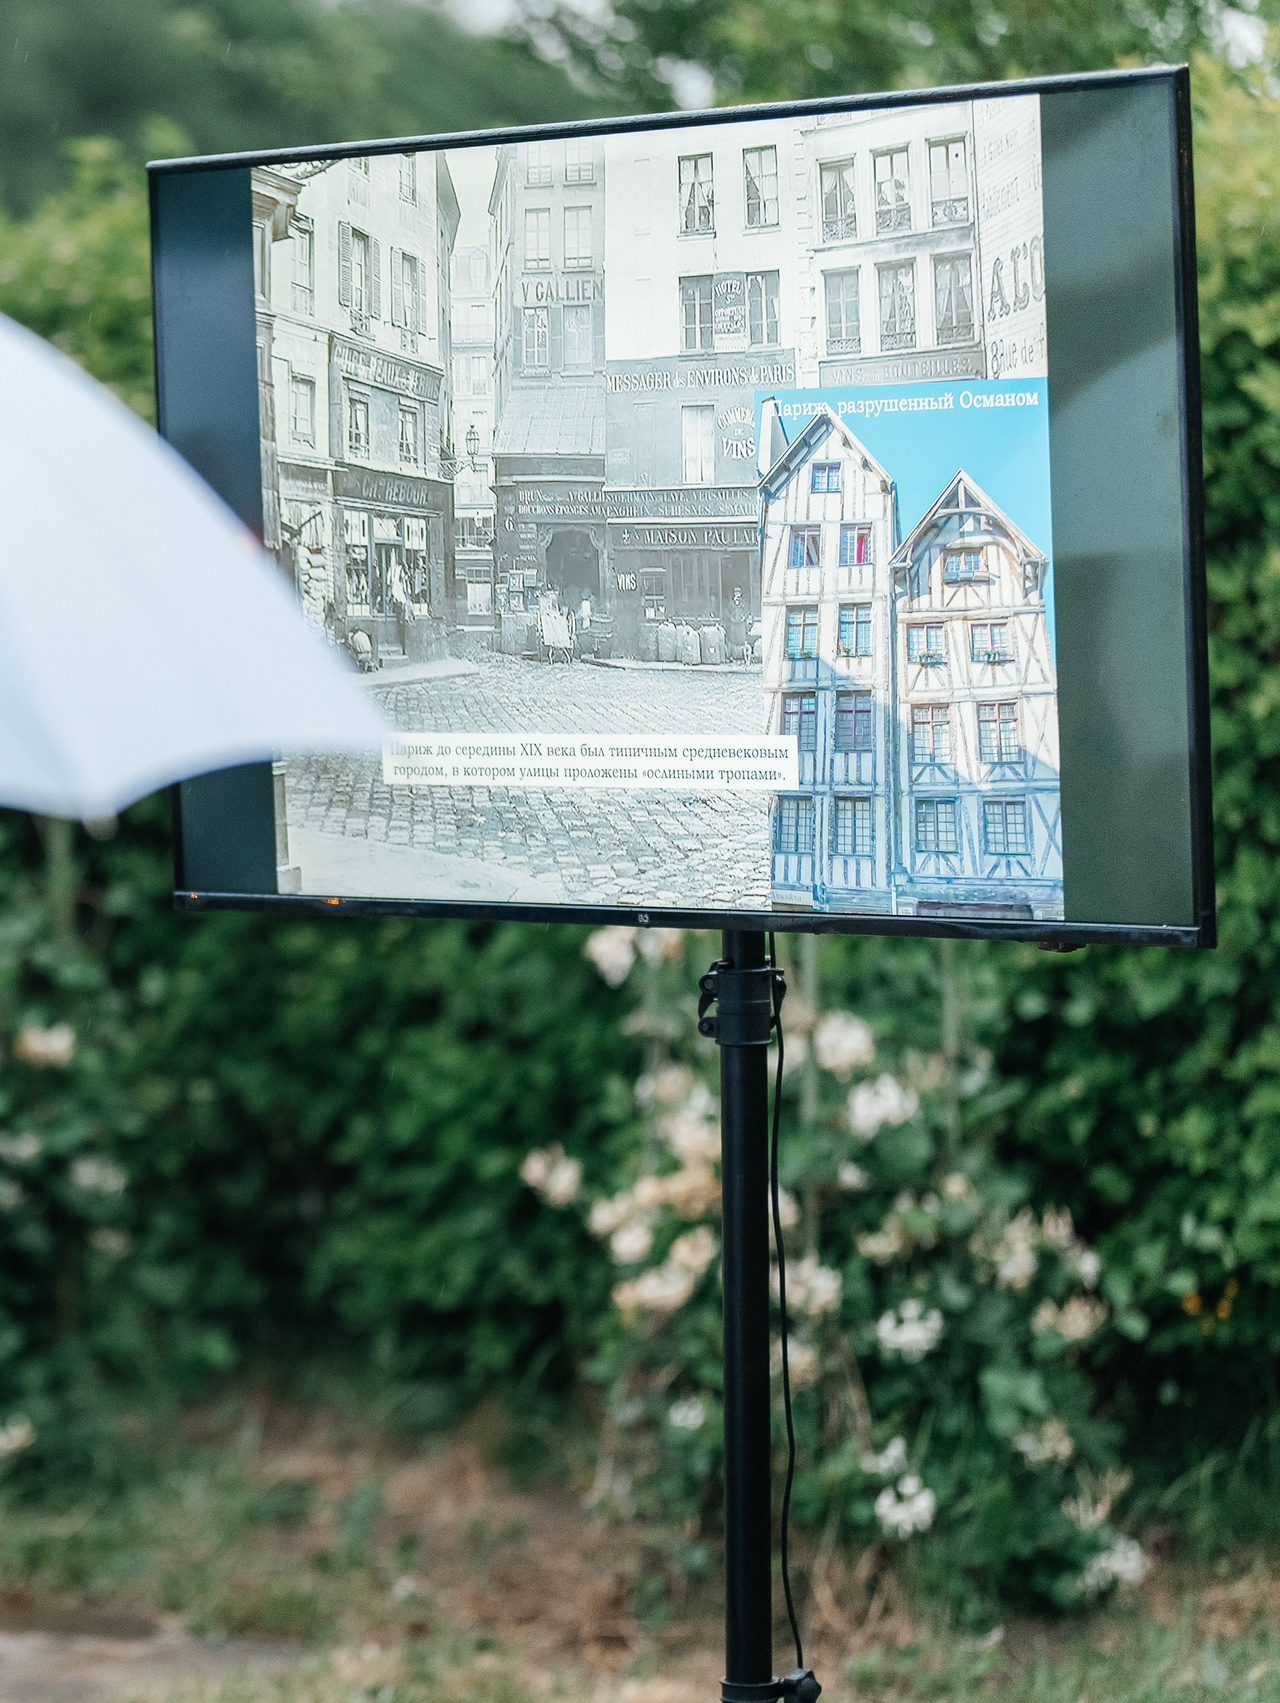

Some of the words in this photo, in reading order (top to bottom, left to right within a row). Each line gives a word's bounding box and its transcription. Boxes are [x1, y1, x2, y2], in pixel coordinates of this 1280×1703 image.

[606, 372, 672, 393] MESSAGER
[687, 366, 747, 388] ENVIRONS
[760, 362, 796, 384] PARIS
[837, 393, 954, 419] разрушенный
[959, 390, 1039, 409] Османом
[722, 435, 756, 459] VINS
[644, 529, 698, 545] MAISON
[617, 573, 638, 592] VINS
[390, 741, 433, 759] Париж
[436, 744, 451, 758] до
[455, 744, 516, 759] середины
[520, 743, 543, 757] XIX
[547, 745, 576, 757] века
[580, 743, 605, 758] был
[609, 746, 678, 758] типичным
[682, 747, 789, 761] средневековым
[394, 766, 448, 779] городом,
[452, 766, 460, 776] в
[463, 766, 516, 780] котором
[519, 767, 559, 780] улицы
[564, 767, 638, 781] проложены
[642, 768, 714, 780] «ослиными
[718, 769, 786, 783] тропами».
